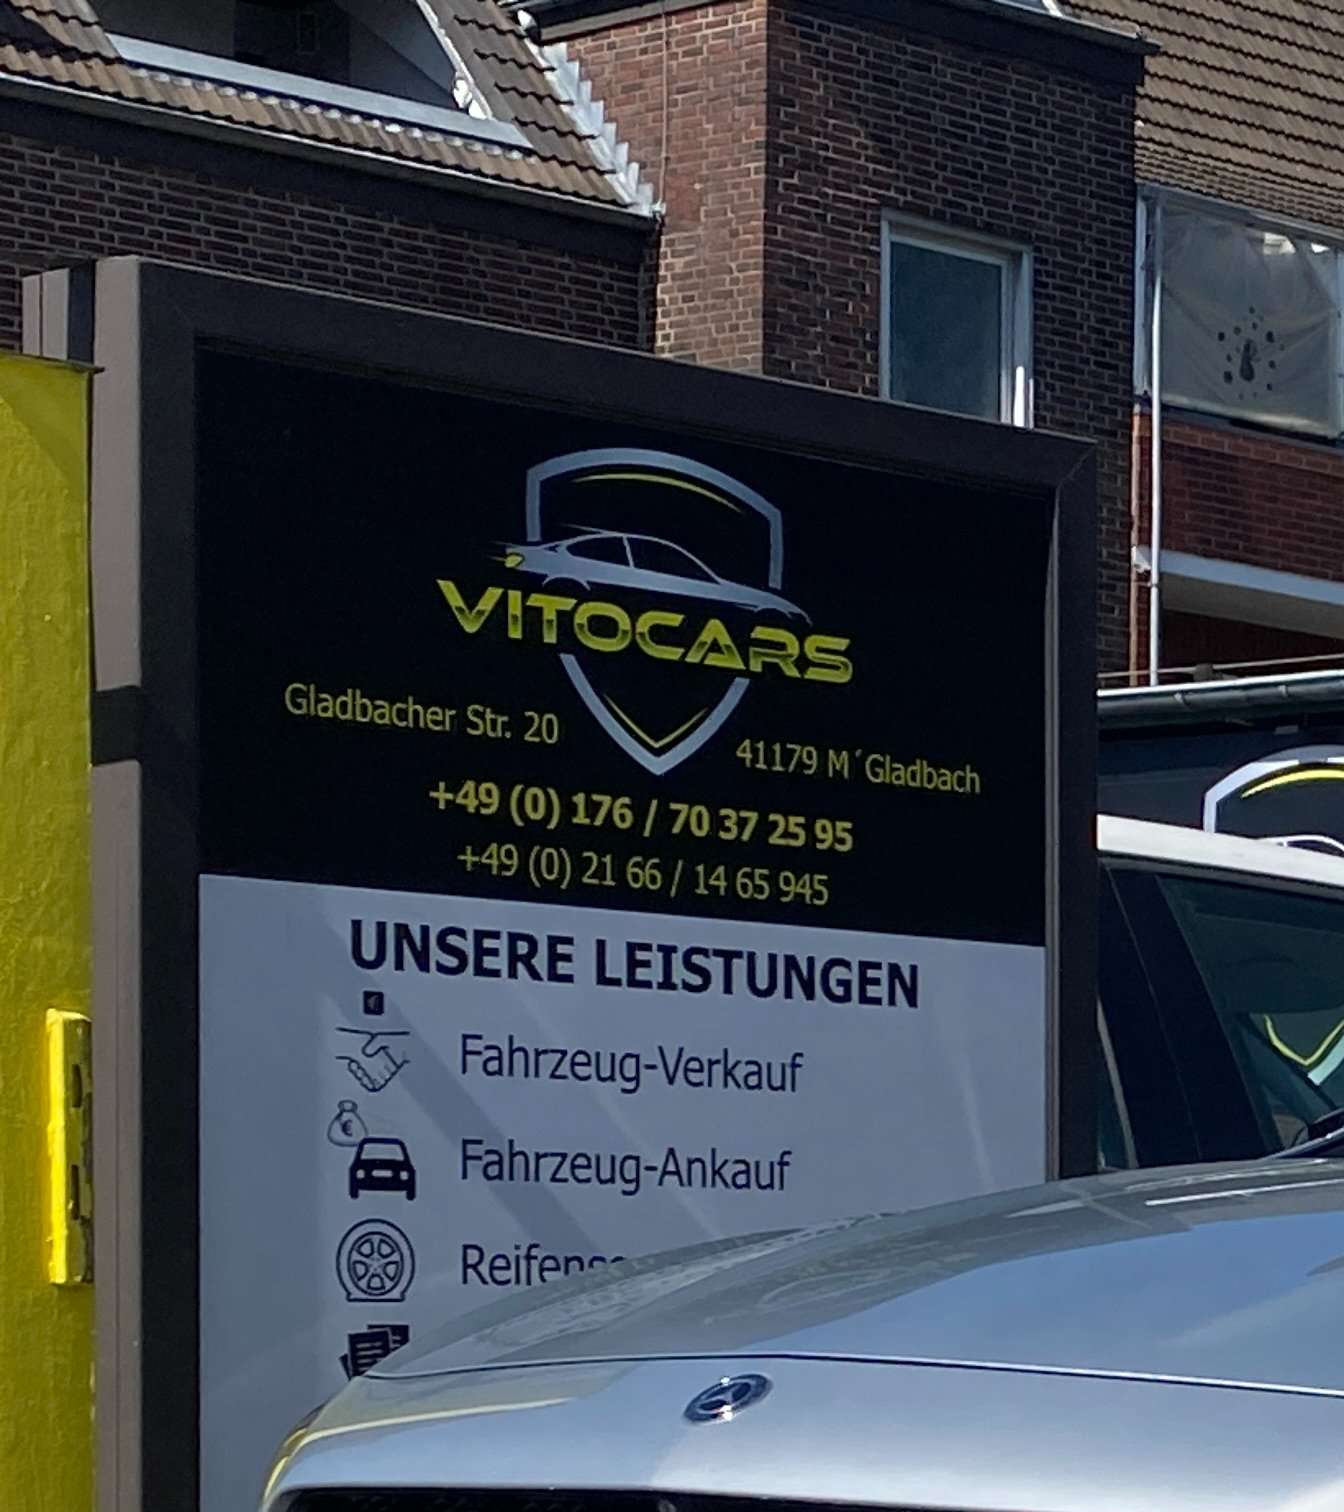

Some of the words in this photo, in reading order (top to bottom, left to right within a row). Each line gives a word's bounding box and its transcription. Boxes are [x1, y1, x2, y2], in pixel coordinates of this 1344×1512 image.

[436, 579, 853, 684] VITOCARS
[284, 683, 456, 732] Gladbacher
[466, 704, 511, 738] Str.
[524, 711, 559, 744] 20
[736, 739, 818, 776] 41179
[429, 779, 499, 815] +49
[510, 784, 561, 830] (0)
[571, 792, 634, 830] 176
[669, 802, 710, 838] 70
[718, 808, 759, 842] 37
[768, 813, 807, 847] 25
[814, 819, 854, 852] 95
[457, 842, 519, 877] +49
[529, 845, 572, 890] (0)
[581, 851, 616, 886] 21
[626, 856, 662, 890] 66
[694, 863, 728, 896] 14
[736, 867, 770, 900] 65
[779, 870, 829, 906] 945
[350, 919, 575, 985] UNSERE
[595, 938, 919, 1009] LEISTUNGEN
[460, 1033, 804, 1095] Fahrzeug-Verkauf
[460, 1138, 792, 1196] Fahrzeug-Ankauf
[461, 1242, 627, 1287] Reifen
